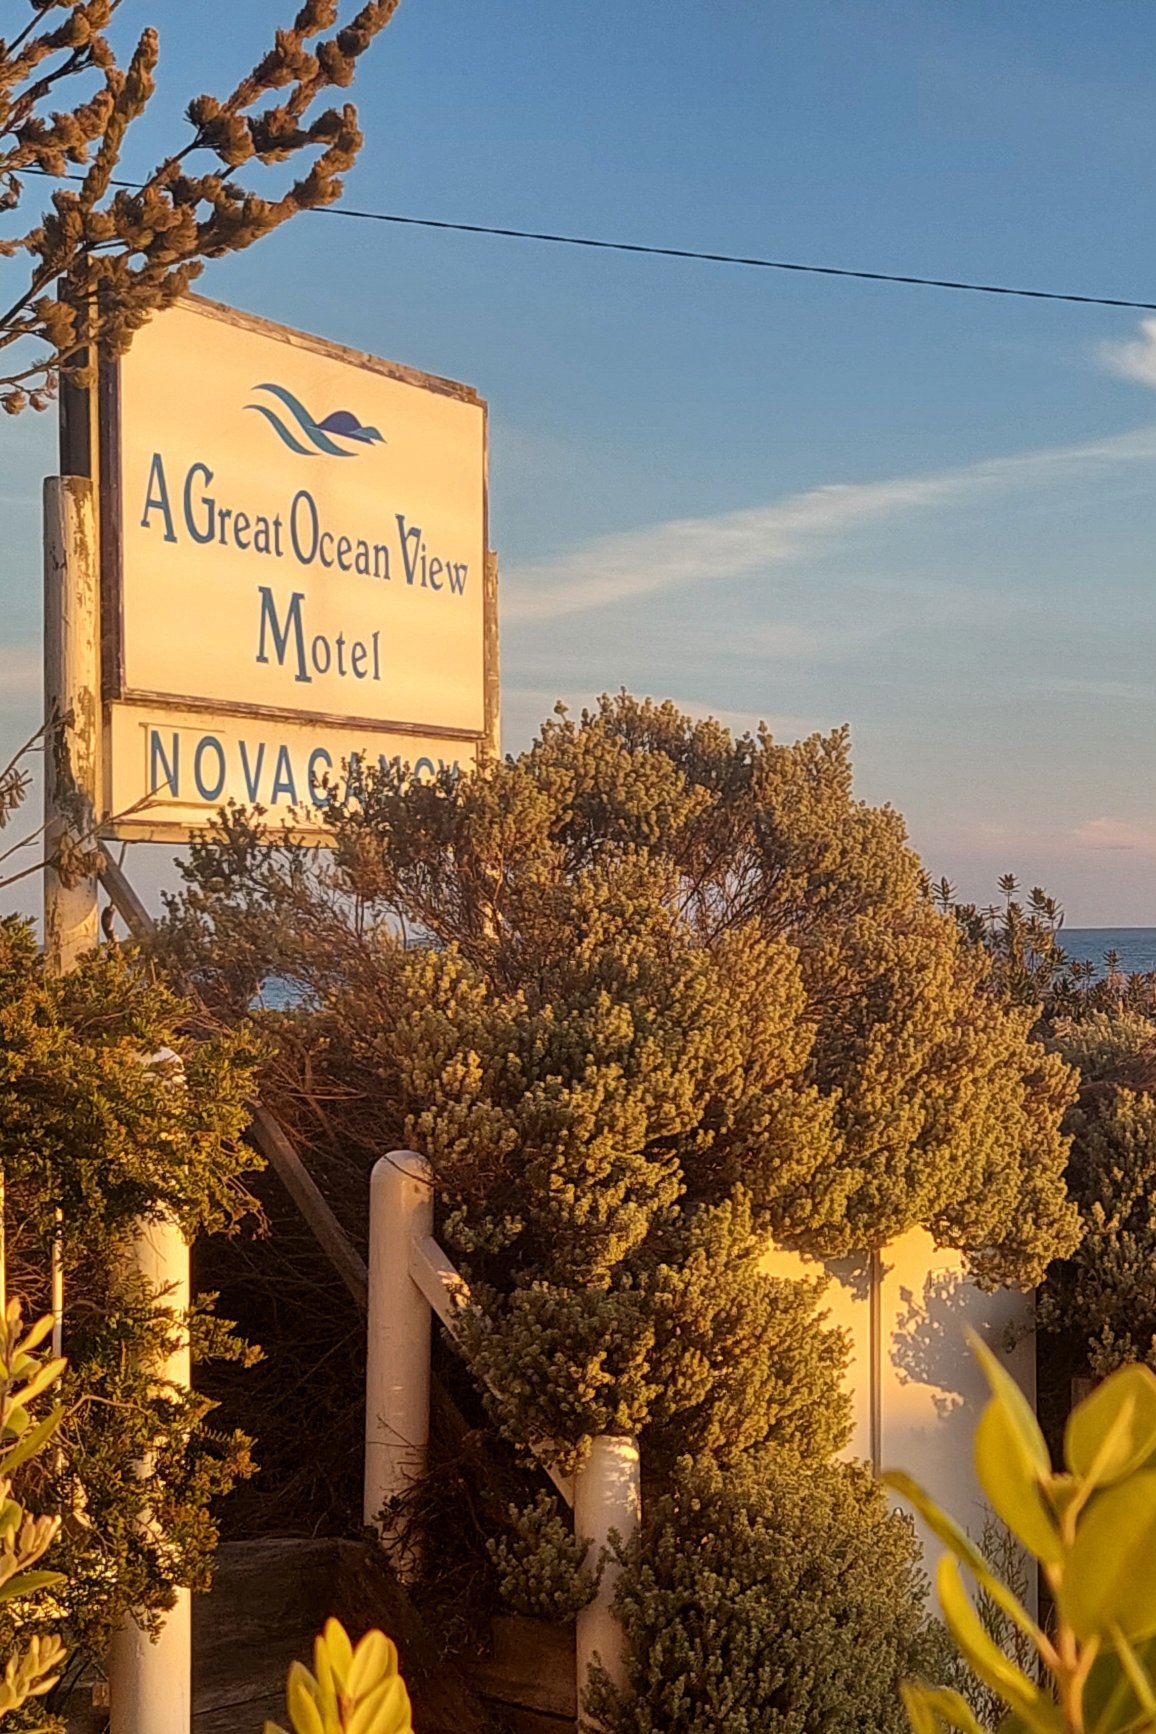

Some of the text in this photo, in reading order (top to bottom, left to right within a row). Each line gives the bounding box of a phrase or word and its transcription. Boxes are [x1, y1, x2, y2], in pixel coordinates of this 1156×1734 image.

[141, 452, 469, 595] A Great Ocean View
[256, 585, 381, 683] Motel
